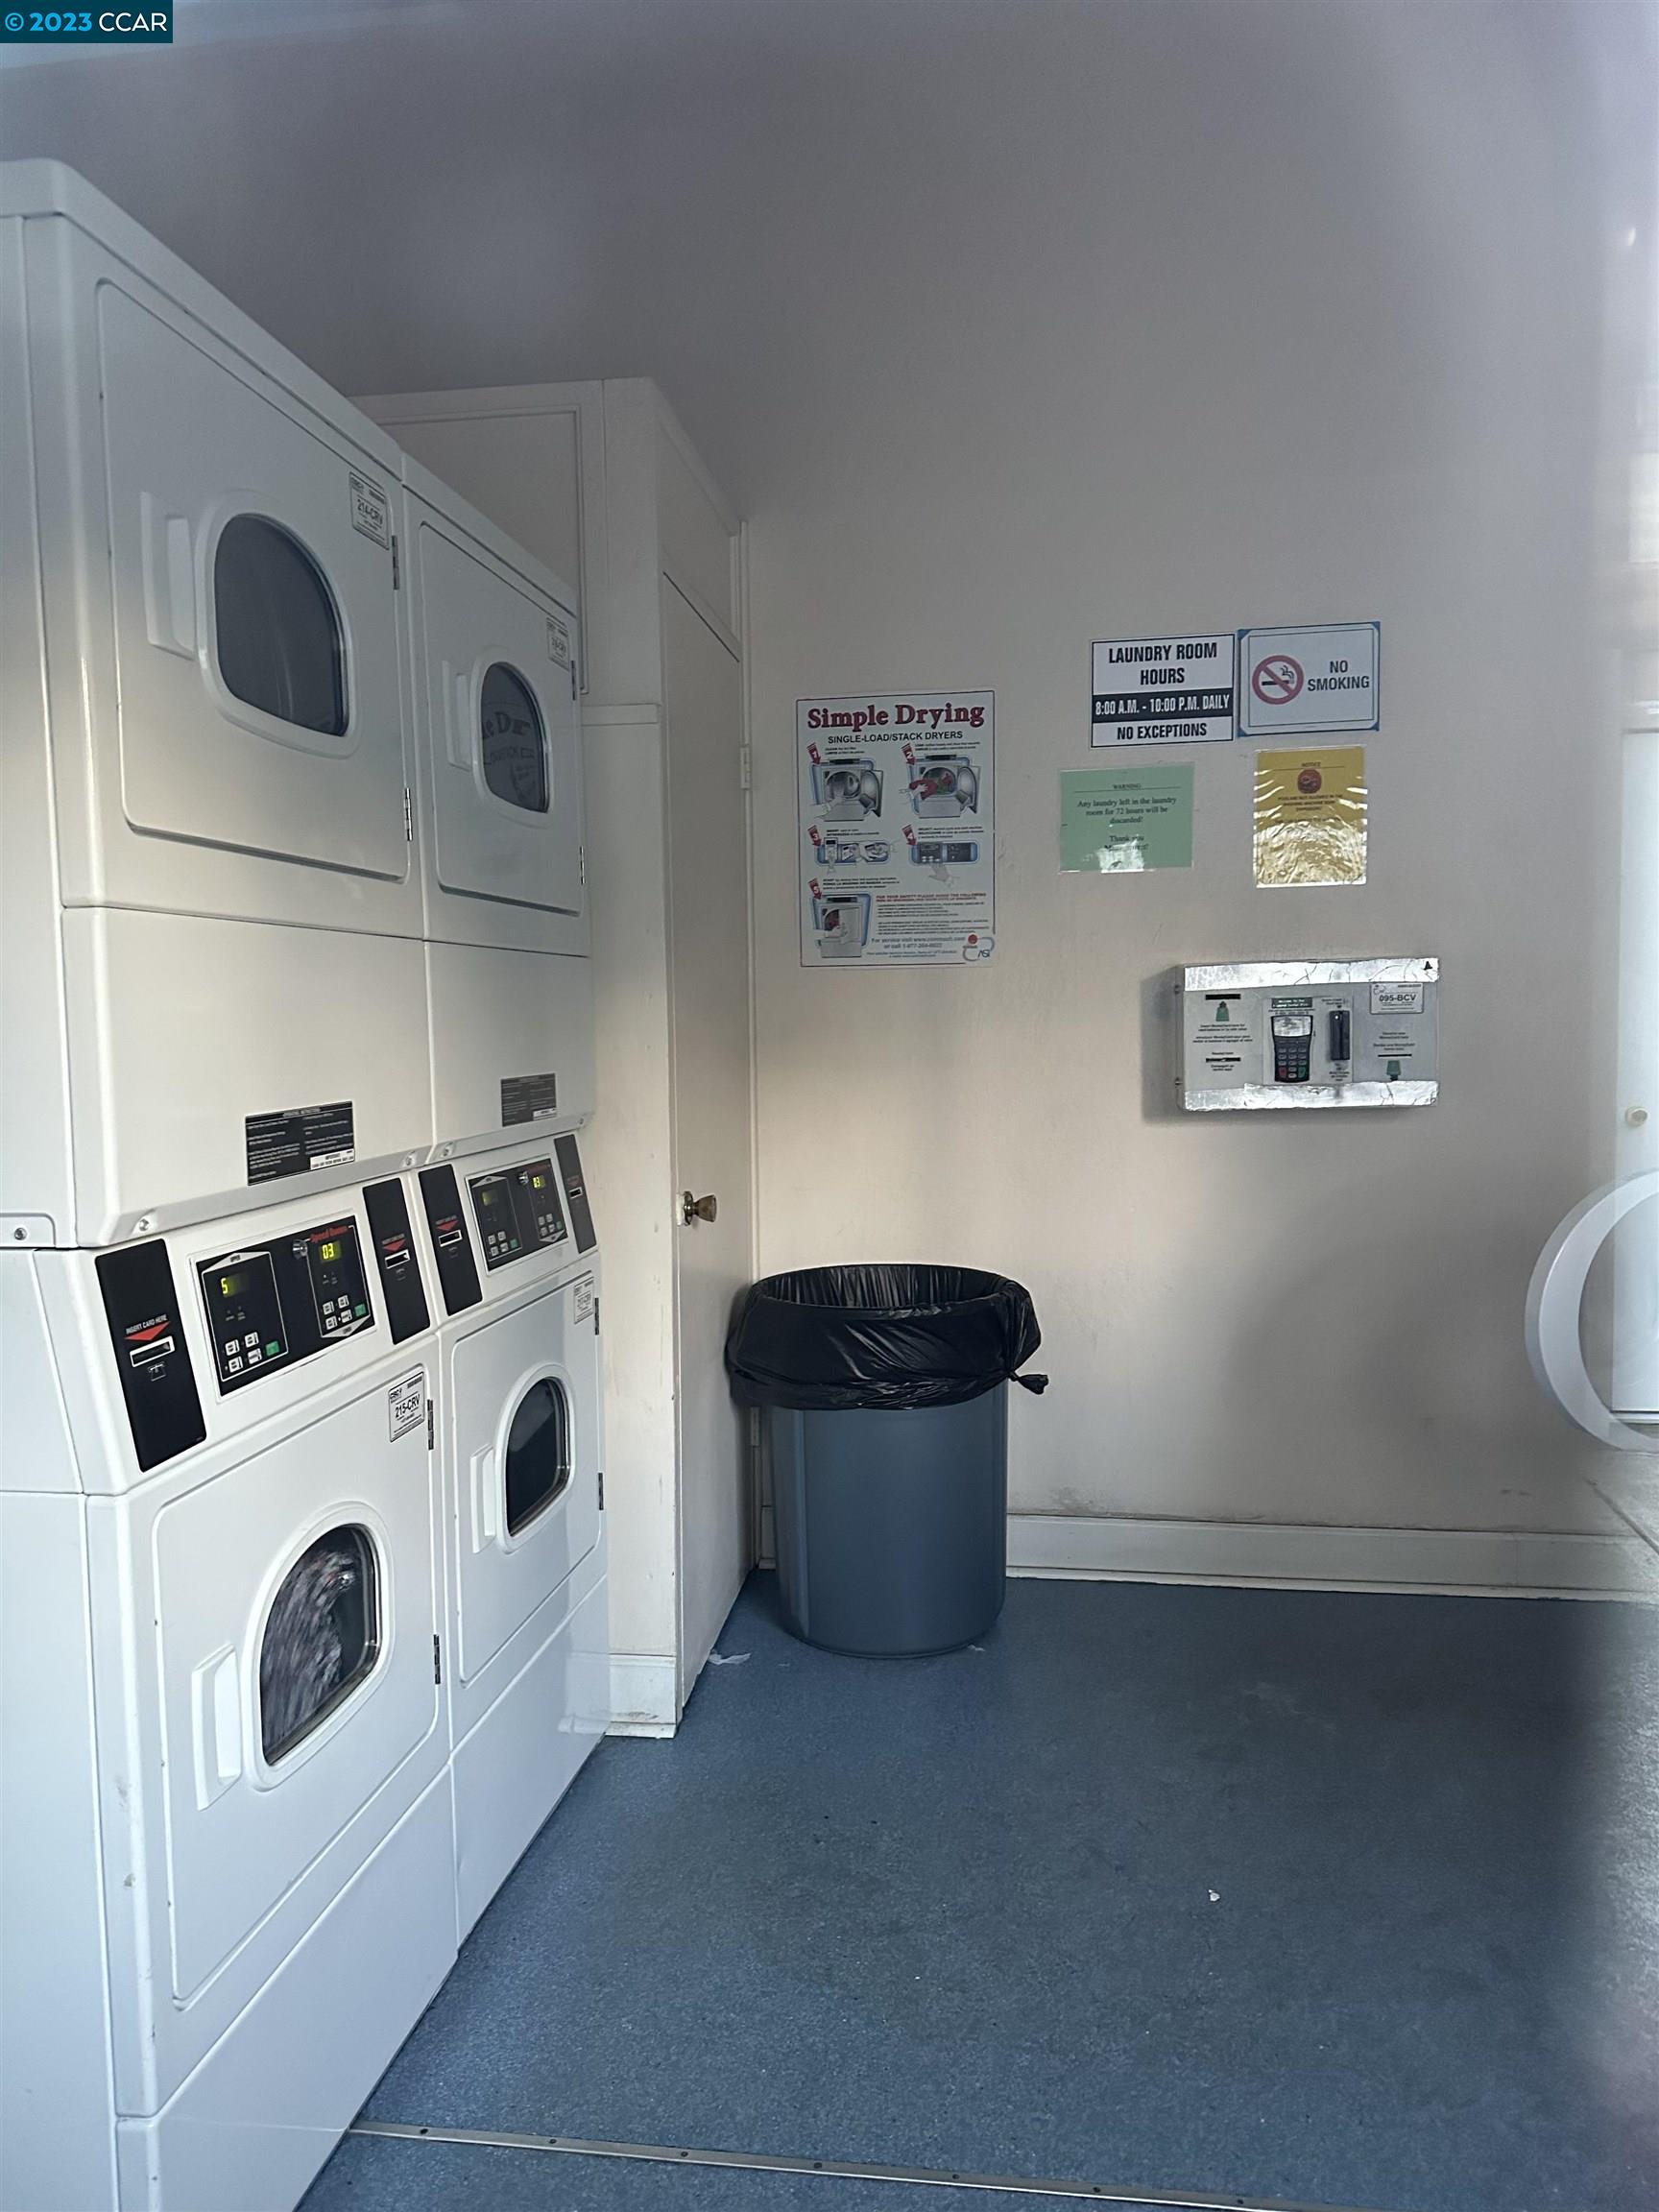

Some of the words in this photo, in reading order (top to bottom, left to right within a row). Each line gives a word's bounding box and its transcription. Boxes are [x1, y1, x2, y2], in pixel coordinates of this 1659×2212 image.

[1109, 644, 1171, 664] LAUNDRY
[1175, 642, 1217, 660] ROOM
[1140, 666, 1185, 685] HOURS
[1330, 661, 1349, 674] NO
[1308, 675, 1370, 692] SMOKING
[1095, 700, 1116, 716] 8:00
[1118, 698, 1140, 714] A.M.
[1150, 697, 1175, 712] 10:00
[1178, 696, 1200, 711] P.M.
[1202, 694, 1230, 710] DAILY
[807, 705, 889, 732] Simple
[895, 703, 985, 730] Drying
[925, 731, 963, 740] DRYERS
[1117, 726, 1135, 740] NO
[1137, 722, 1207, 739] EXCEPTIONS
[1077, 800, 1092, 808] Any
[1093, 799, 1118, 807] laundry
[1151, 796, 1177, 805] laundry
[142, 1318, 156, 1329] CARD
[395, 1394, 421, 1418] 215-CRV
